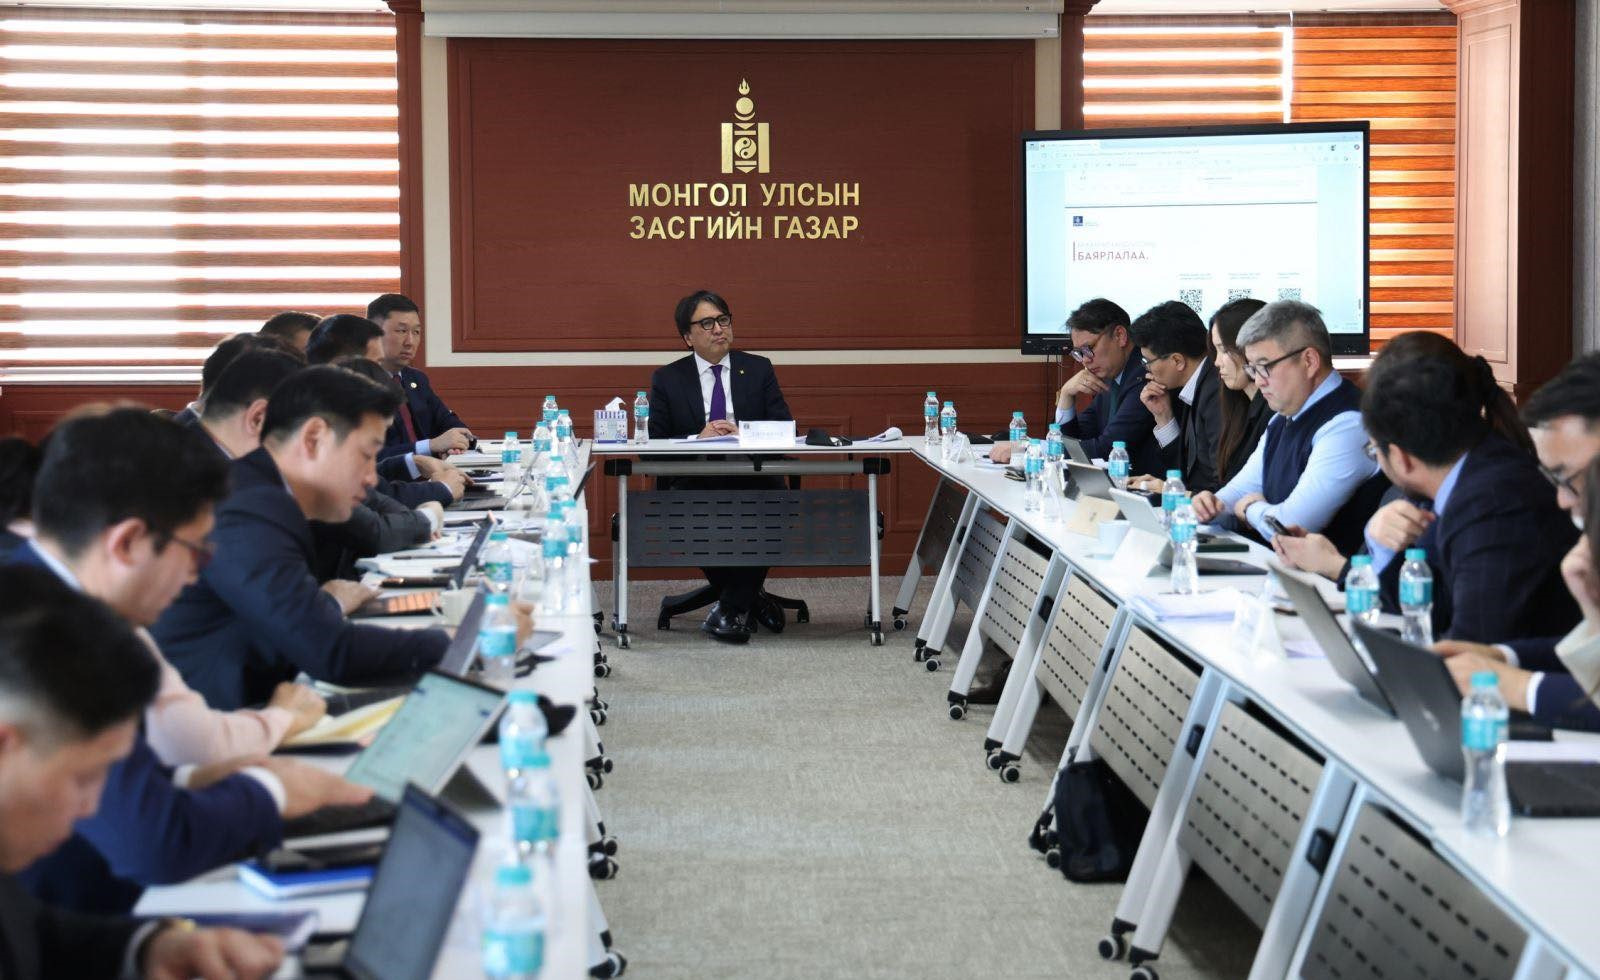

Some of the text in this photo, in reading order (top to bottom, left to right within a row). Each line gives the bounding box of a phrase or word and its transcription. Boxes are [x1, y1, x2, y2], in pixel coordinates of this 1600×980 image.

[629, 183, 860, 207] МОНГОЛ УЛСЫН
[629, 211, 859, 240] ЗАСГИЙН ГАЗАР
